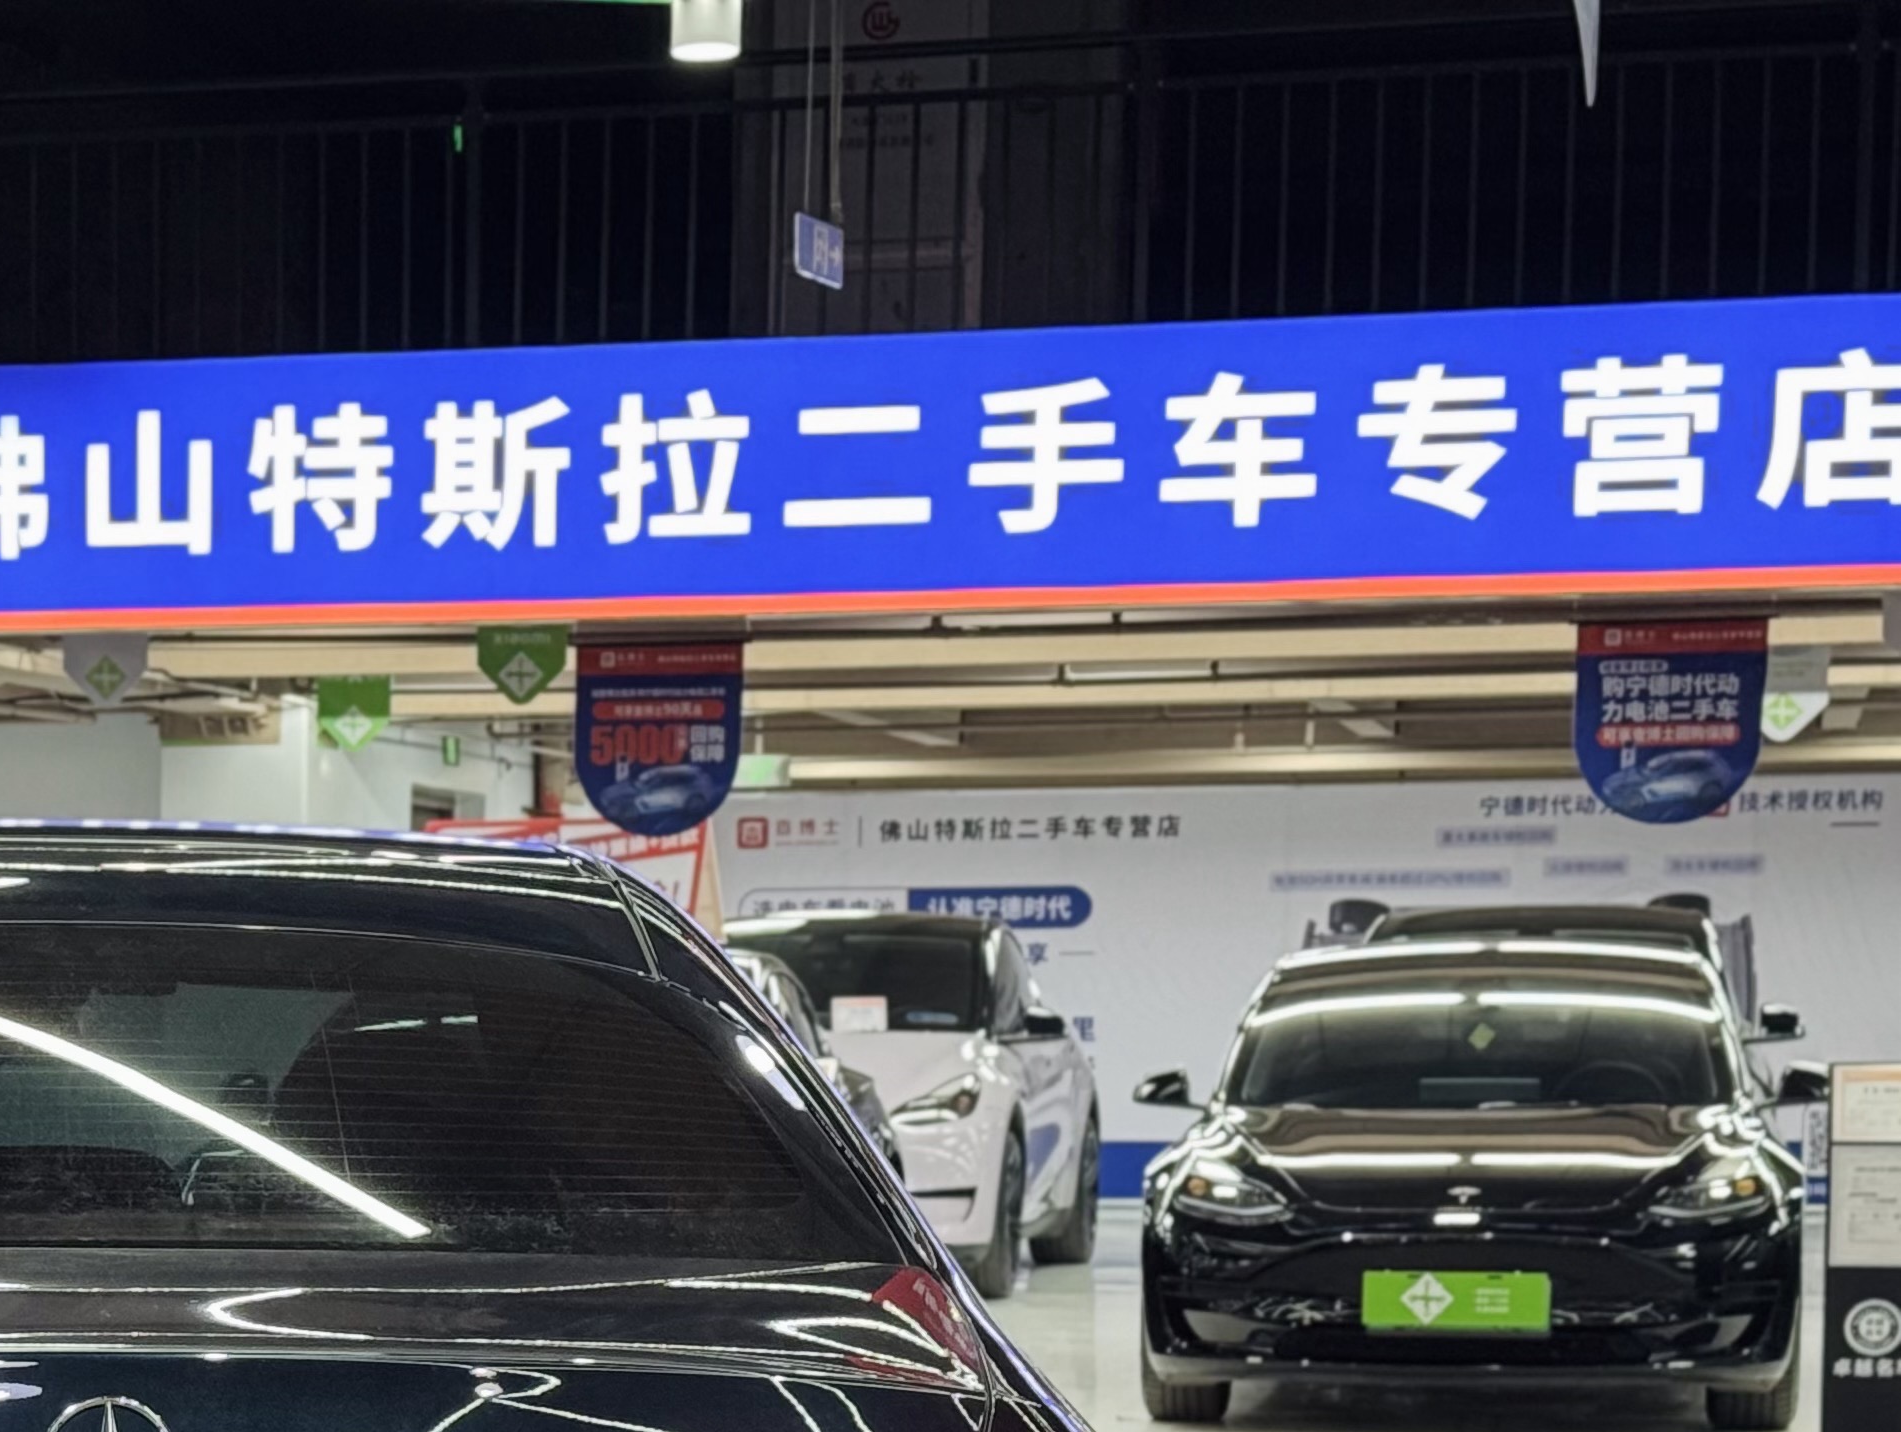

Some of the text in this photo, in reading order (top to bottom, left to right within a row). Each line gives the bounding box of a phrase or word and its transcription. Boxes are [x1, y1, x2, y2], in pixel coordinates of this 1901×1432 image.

[879, 815, 1181, 842] 佛山特斯拉二手车专营店
